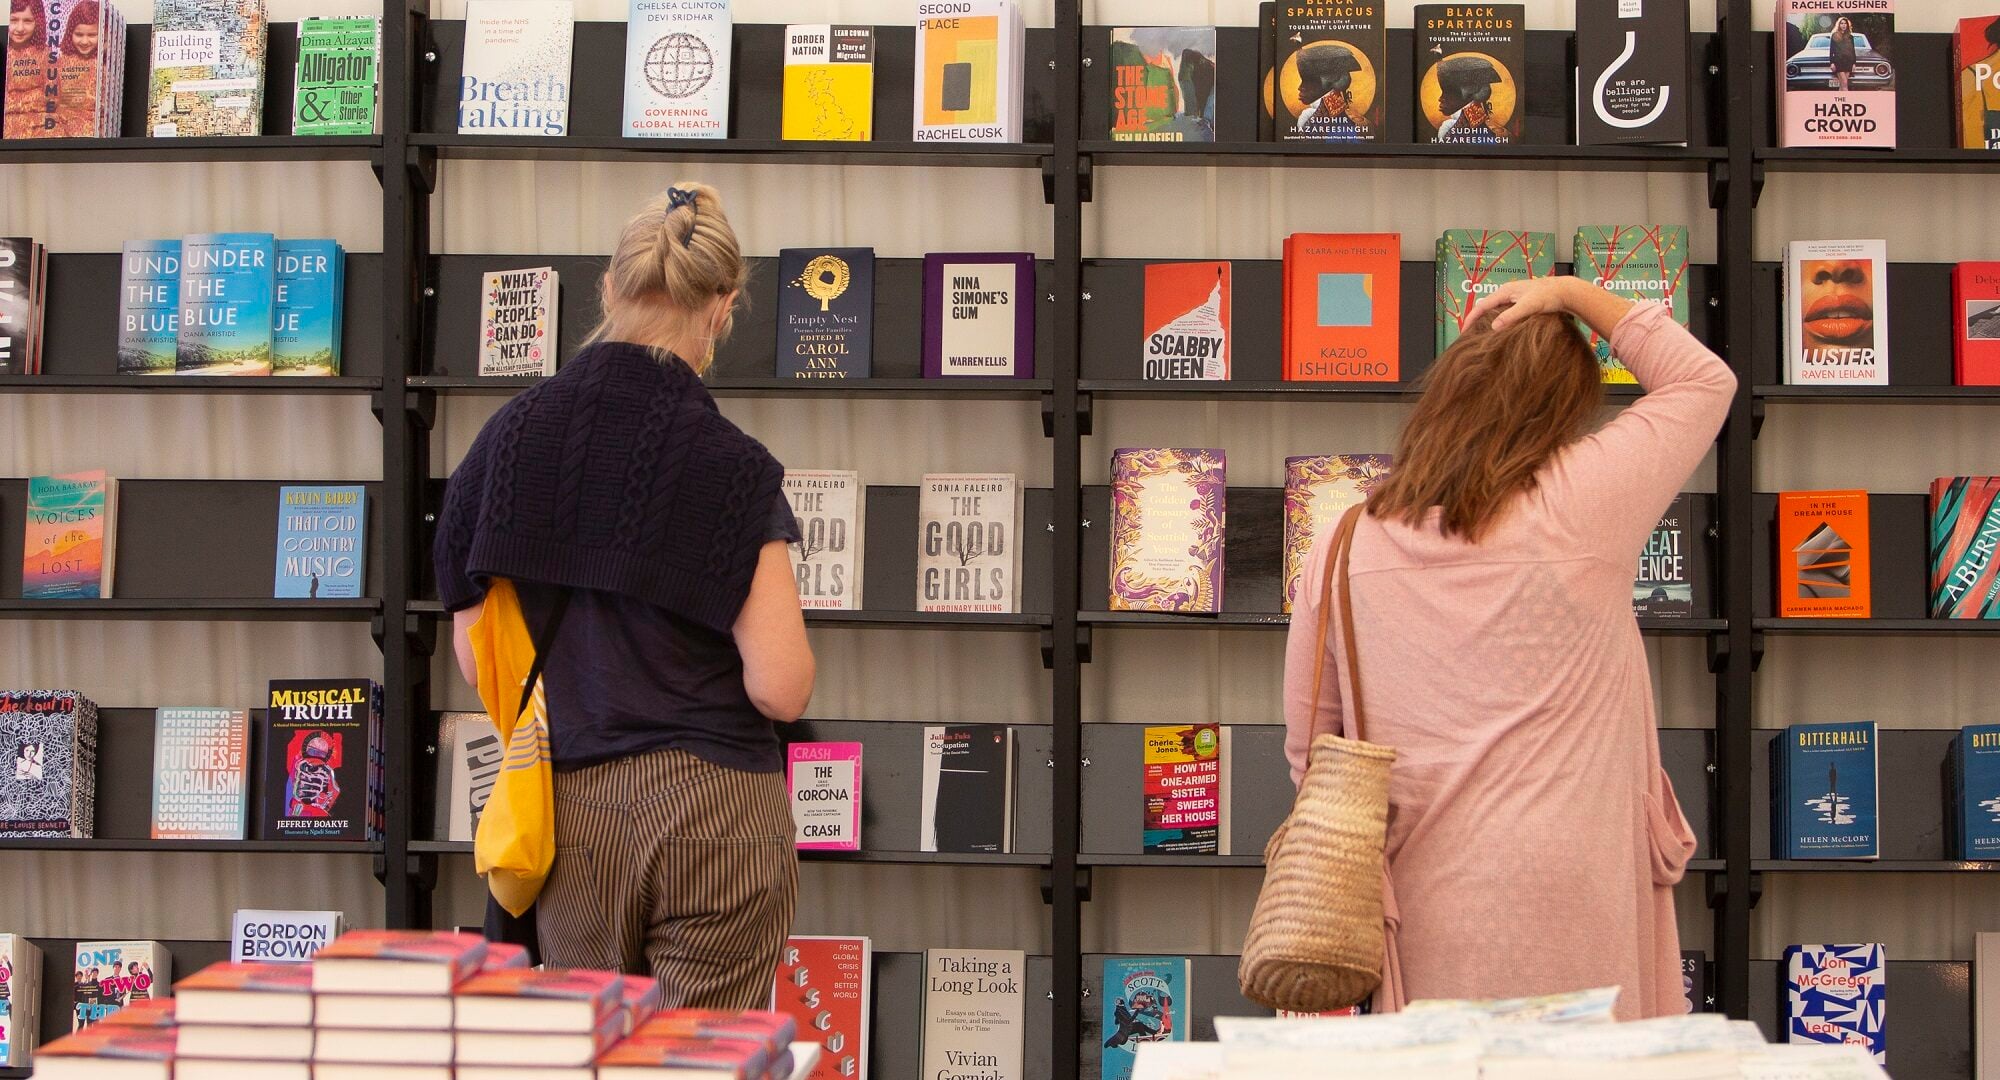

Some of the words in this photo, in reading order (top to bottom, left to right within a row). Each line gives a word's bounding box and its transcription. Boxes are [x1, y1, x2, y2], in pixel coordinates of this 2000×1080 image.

[637, 2, 679, 11] CHELSEA
[681, 1, 726, 10] CLINTON
[919, 3, 971, 15] SECOND
[1446, 7, 1494, 17] BLACK
[1791, 1, 1835, 9] RACHEL
[1837, 1, 1888, 9] KUSHNER
[647, 13, 670, 22] DEVI
[671, 13, 714, 22] SRIDHAR
[919, 18, 960, 30] PLACE
[1428, 19, 1513, 29] SPARTACUS
[791, 34, 825, 45] BORDER
[834, 29, 848, 37] LEAH
[849, 29, 870, 37] COWAN
[159, 34, 213, 49] Building
[302, 35, 331, 47] Dima
[334, 34, 374, 48] Alzayat
[837, 43, 841, 51] A
[842, 43, 858, 52] Story
[859, 43, 866, 51] of
[158, 49, 176, 61] for
[180, 49, 214, 62] Hope
[791, 46, 824, 56] NATION
[836, 52, 866, 60] Migration
[13, 59, 37, 67] ARIFA
[44, 2, 61, 130] CONSUMED
[301, 52, 372, 85] Alligator
[13, 69, 41, 77] AKBAR
[1116, 65, 1145, 86] THE
[460, 75, 566, 102] Breath
[1606, 86, 1655, 98] bellingcat
[340, 90, 362, 105] Other
[1115, 86, 1169, 109] STONE
[299, 91, 331, 123] &
[339, 105, 368, 121] Stories
[645, 108, 708, 117] GOVERNING
[1814, 103, 1867, 117] HARD
[457, 101, 565, 136] taking
[632, 120, 674, 129] GLOBAL
[676, 120, 720, 129] HEALTH
[1115, 108, 1148, 131] AGE
[1451, 126, 1489, 135] SUDHIR
[1804, 119, 1877, 133] CROWD
[917, 129, 967, 141] RACHEL
[968, 127, 1003, 138] CUSK
[1431, 136, 1509, 144] HAZAREESINGH
[1305, 247, 1332, 255] KLARA
[187, 249, 265, 268] UNDER
[185, 278, 226, 297] THE
[501, 272, 537, 289] WHAT
[953, 276, 980, 290] NINA
[1592, 277, 1670, 291] Common
[498, 289, 537, 306] WHITE
[952, 291, 1008, 305] SIMONE'S
[184, 307, 237, 326] BLUE
[495, 306, 538, 324] PEOPLE
[952, 306, 978, 319] GUM
[789, 314, 827, 327] Empty
[832, 314, 858, 324] Nest
[495, 325, 518, 341] CAN
[520, 324, 536, 339] DO
[800, 334, 832, 342] EDITED
[501, 343, 531, 360] NEXT
[796, 343, 849, 355] CAROL
[1149, 333, 1223, 359] SCABBY
[1320, 347, 1368, 359] KAZUO
[805, 357, 837, 369] ANN
[949, 356, 983, 367] WARREN
[984, 356, 1007, 367] ELLIS
[1801, 348, 1875, 366] LUSTER
[1146, 358, 1204, 380] QUEEN
[1299, 362, 1389, 376] ISHIGURO
[1801, 370, 1835, 379] RAVEN
[1839, 369, 1875, 379] LEILANI
[931, 484, 960, 492] SONIA
[964, 484, 1003, 492] FALEIRO
[950, 496, 981, 516] THE
[1825, 509, 1853, 517] HOUSE
[36, 508, 95, 525] VOICES
[287, 515, 322, 531] THAT
[324, 515, 356, 531] OLD
[44, 534, 56, 545] of
[64, 532, 84, 543] the
[284, 537, 356, 552] COUNTRY
[925, 520, 1005, 557] GOOD
[41, 560, 82, 575] LOST
[284, 556, 355, 577] MUSIC
[924, 567, 1004, 601] GIRLS
[936, 604, 972, 612] ORDINARY
[974, 603, 1002, 612] KILLING
[270, 687, 366, 708] MUSICAL
[281, 703, 353, 720] TRUTH
[1799, 730, 1869, 746] BITTERHALL
[930, 741, 969, 750] Occupation
[160, 746, 228, 770] FUTURES
[230, 752, 241, 766] OF
[814, 766, 833, 778] THE
[1174, 763, 1197, 774] HOW
[1199, 761, 1217, 772] THE
[159, 770, 240, 795] SOCIALISM
[1160, 773, 1217, 787] ONE-ARMED
[797, 788, 848, 802] CORONA
[1171, 787, 1206, 799] SISTER
[1176, 798, 1215, 811] SWEEPS
[276, 820, 313, 829] JEFFREY
[314, 819, 349, 828] BOAKYE
[1161, 813, 1182, 824] HER
[1185, 810, 1217, 822] HOUSE
[803, 824, 841, 837] CRASH
[1800, 835, 1828, 844] HELEN
[1831, 834, 1870, 843] McCLORY
[242, 922, 327, 939] GORDON
[241, 940, 326, 958] BROWN
[77, 948, 122, 967] ONE
[1821, 957, 1847, 969] Jon
[939, 957, 1000, 977] Taking
[1001, 962, 1012, 974] a
[99, 974, 151, 996] TWO
[834, 982, 858, 990] BETTER
[931, 977, 974, 996] Long
[977, 977, 1018, 994] Look
[1797, 974, 1872, 988] McGregor
[832, 991, 857, 999] WORLD
[1805, 1022, 1841, 1033] Lean
[945, 1050, 998, 1067] Vivian
